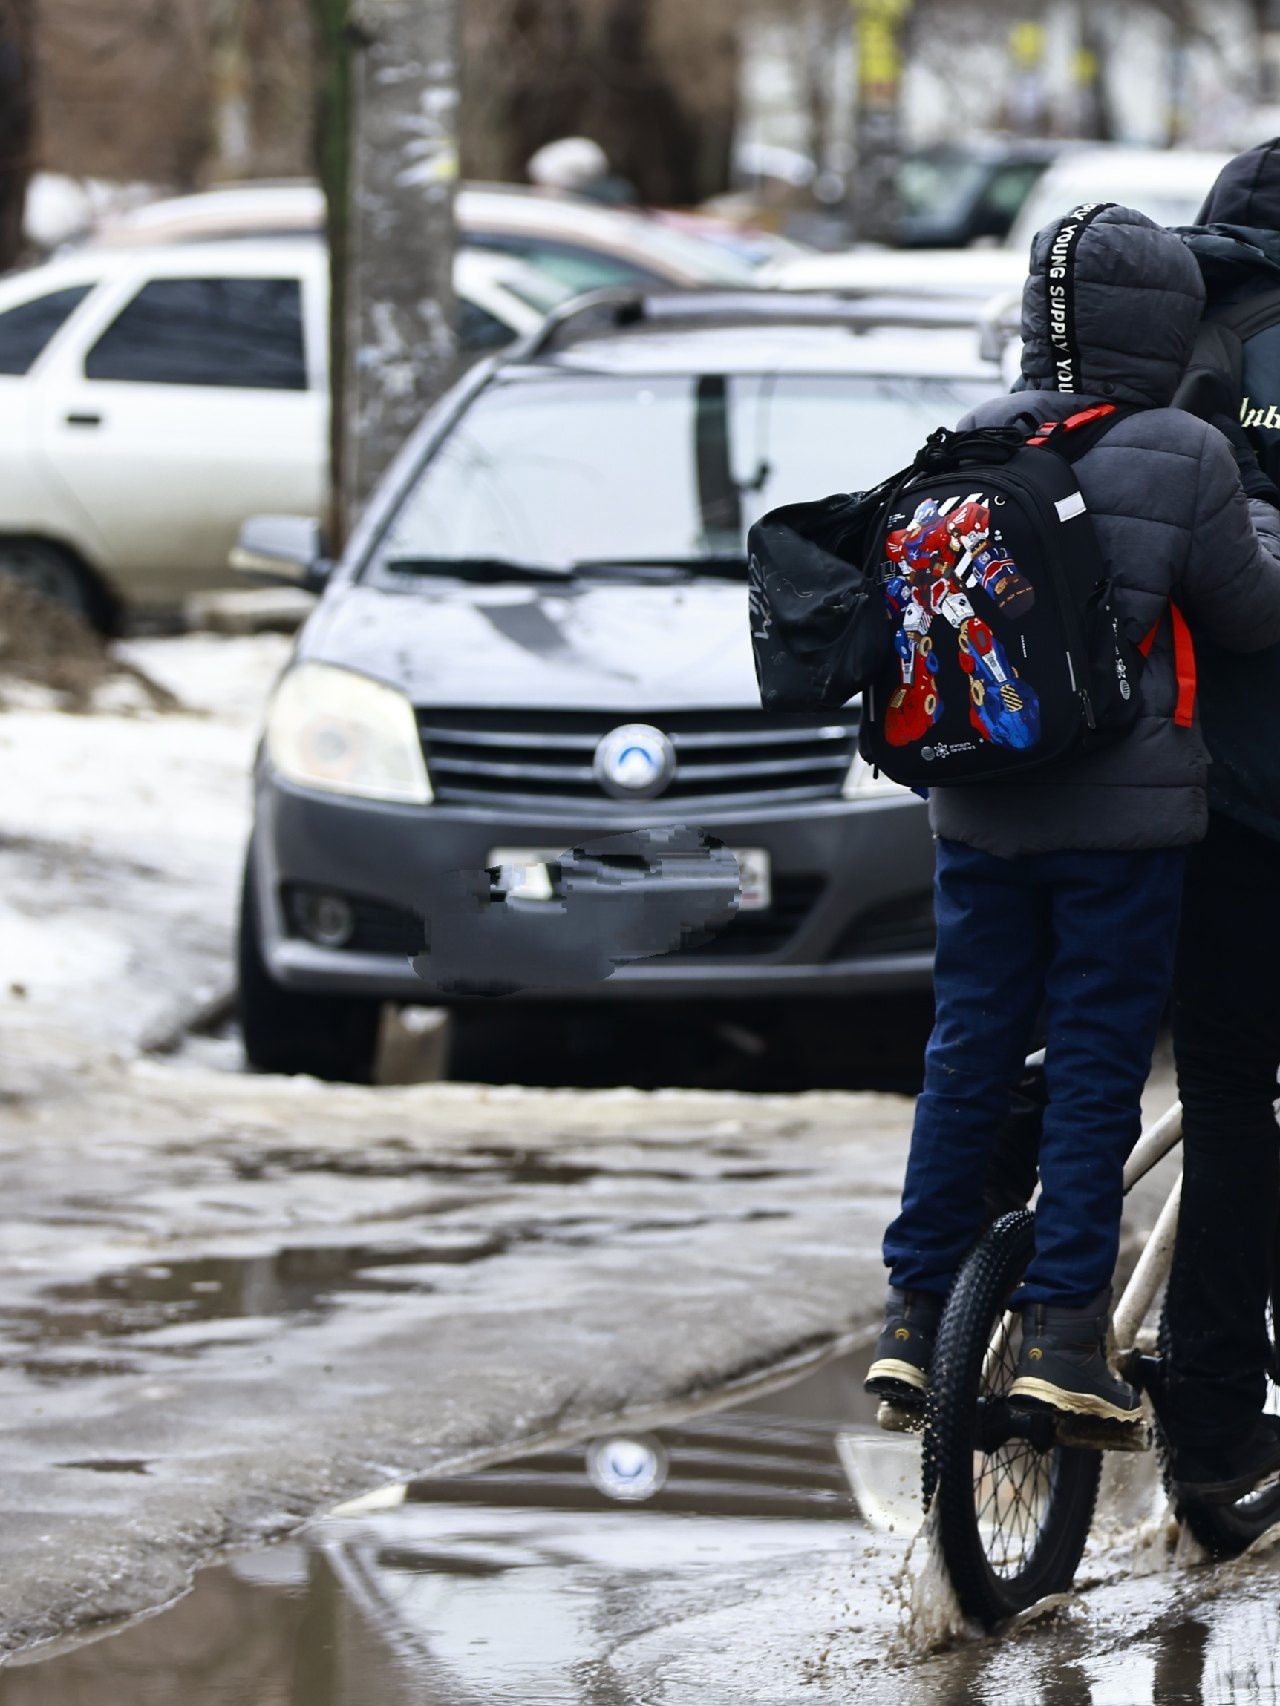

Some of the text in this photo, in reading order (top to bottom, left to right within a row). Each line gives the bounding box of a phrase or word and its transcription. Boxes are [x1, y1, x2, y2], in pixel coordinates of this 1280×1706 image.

[1069, 202, 1103, 221] PLY
[1049, 224, 1078, 279] YOUNG
[1049, 285, 1070, 352] SUPPLY
